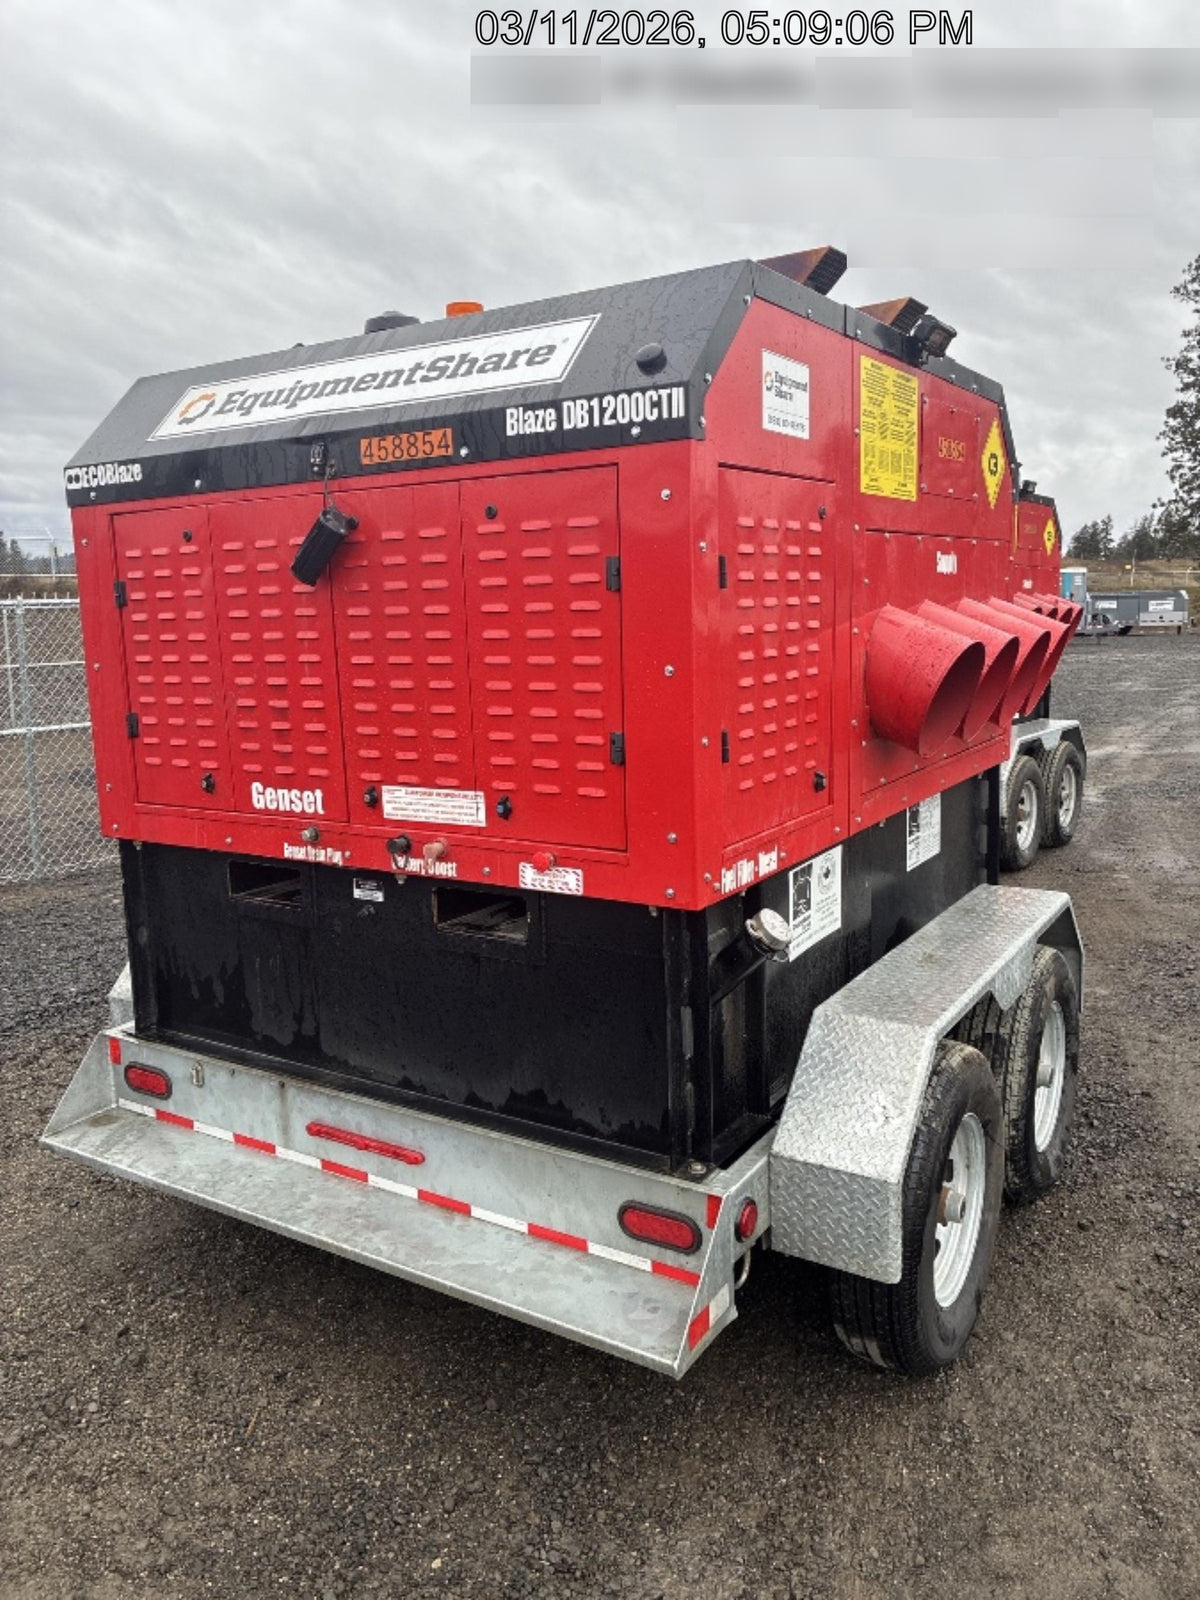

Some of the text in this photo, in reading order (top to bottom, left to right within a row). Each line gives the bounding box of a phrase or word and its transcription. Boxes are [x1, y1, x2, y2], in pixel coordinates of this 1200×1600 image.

[213, 341, 559, 418] EquipmentShare
[505, 386, 686, 437] Blaze DB1200CTII
[362, 430, 450, 462] 458854
[250, 781, 325, 815] Genset
